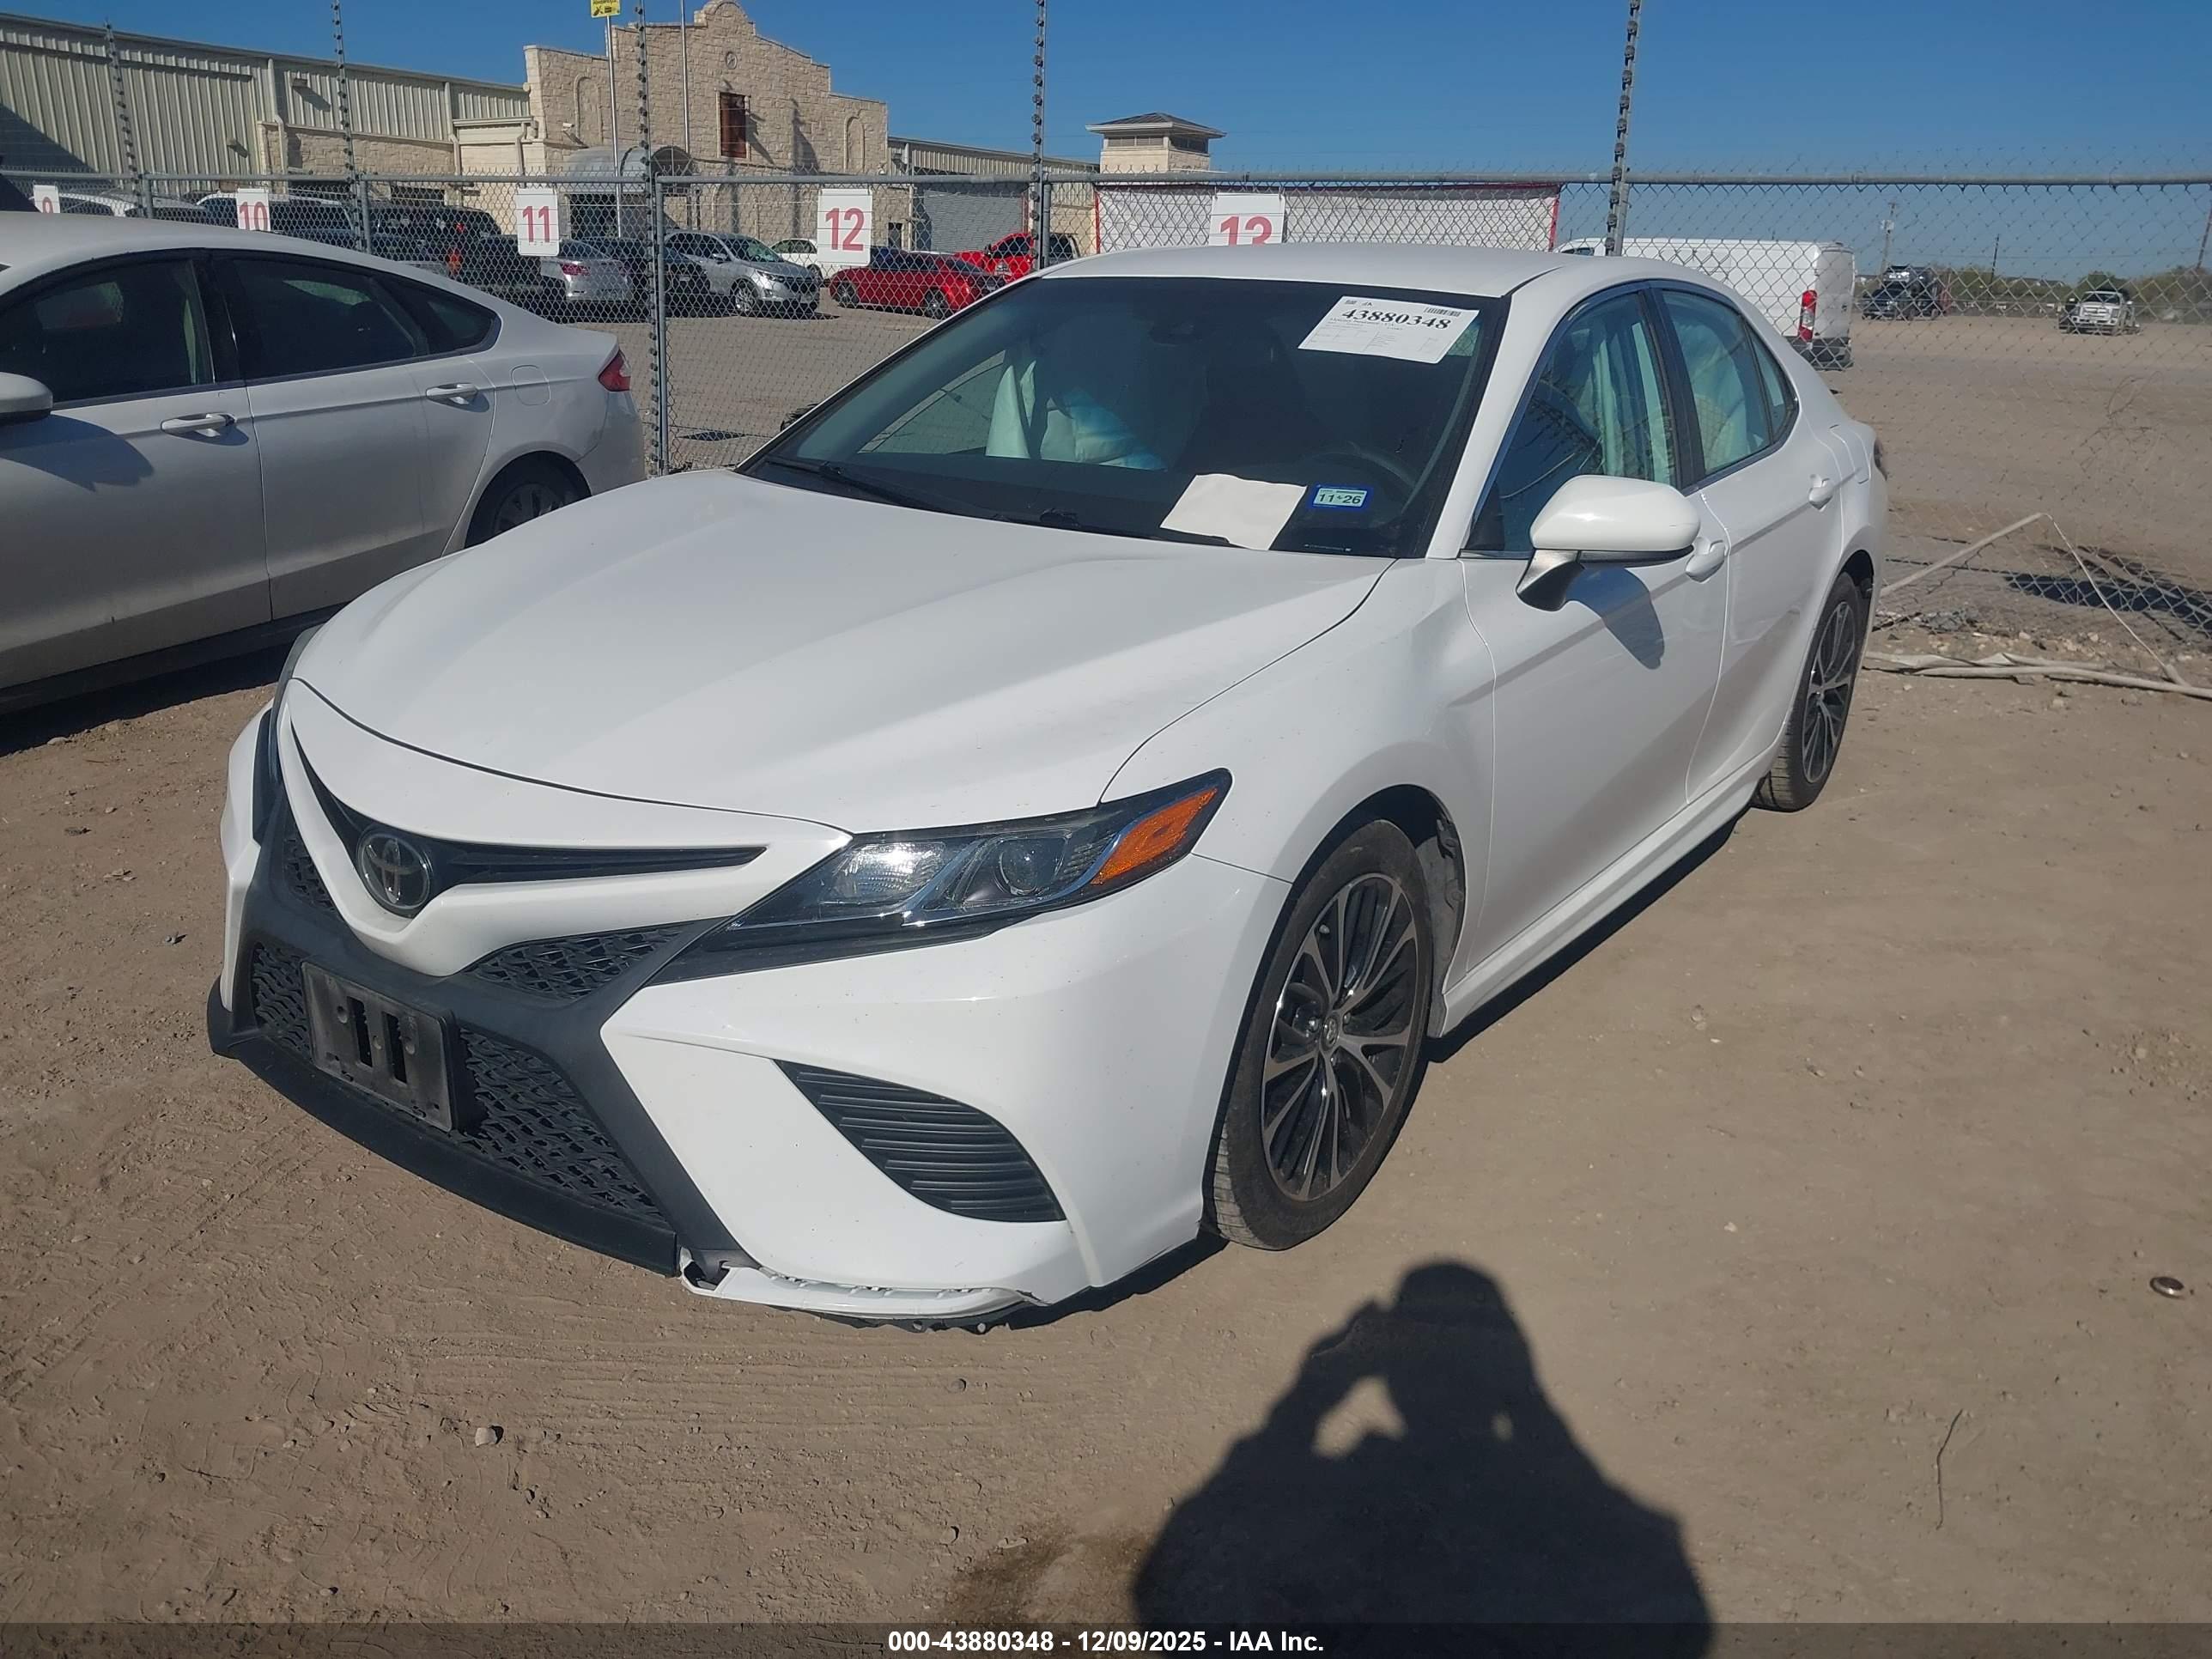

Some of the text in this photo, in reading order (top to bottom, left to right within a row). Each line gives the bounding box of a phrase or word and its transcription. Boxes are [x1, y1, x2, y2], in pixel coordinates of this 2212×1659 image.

[240, 201, 268, 230] 10
[522, 205, 550, 243] 11
[825, 207, 865, 251] 12
[1342, 309, 1451, 329] 43880348
